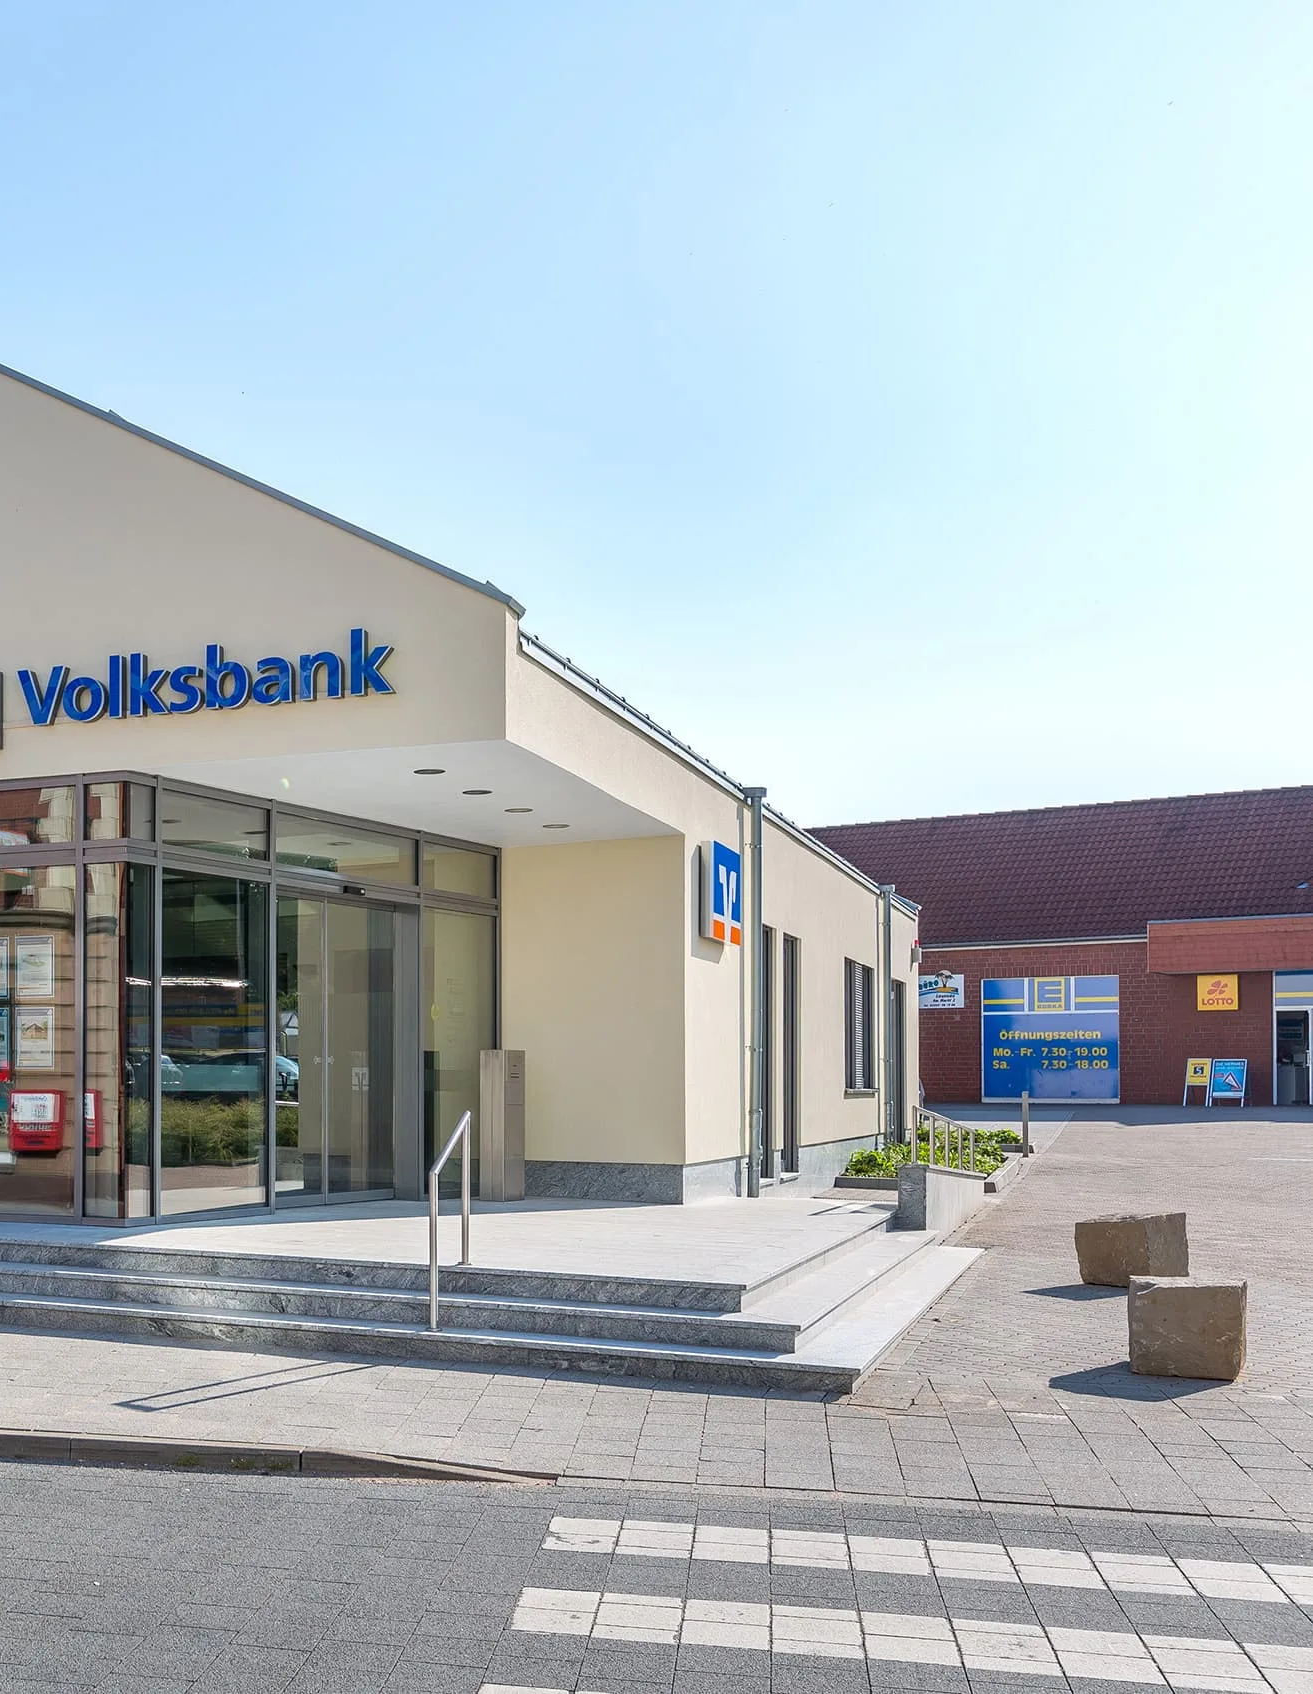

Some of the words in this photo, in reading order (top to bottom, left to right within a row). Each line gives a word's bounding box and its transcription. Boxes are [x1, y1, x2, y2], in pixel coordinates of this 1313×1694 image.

[16, 627, 396, 726] Volksbank
[999, 1028, 1102, 1041] Öffnungszeiten
[992, 1060, 1011, 1070] Sa.
